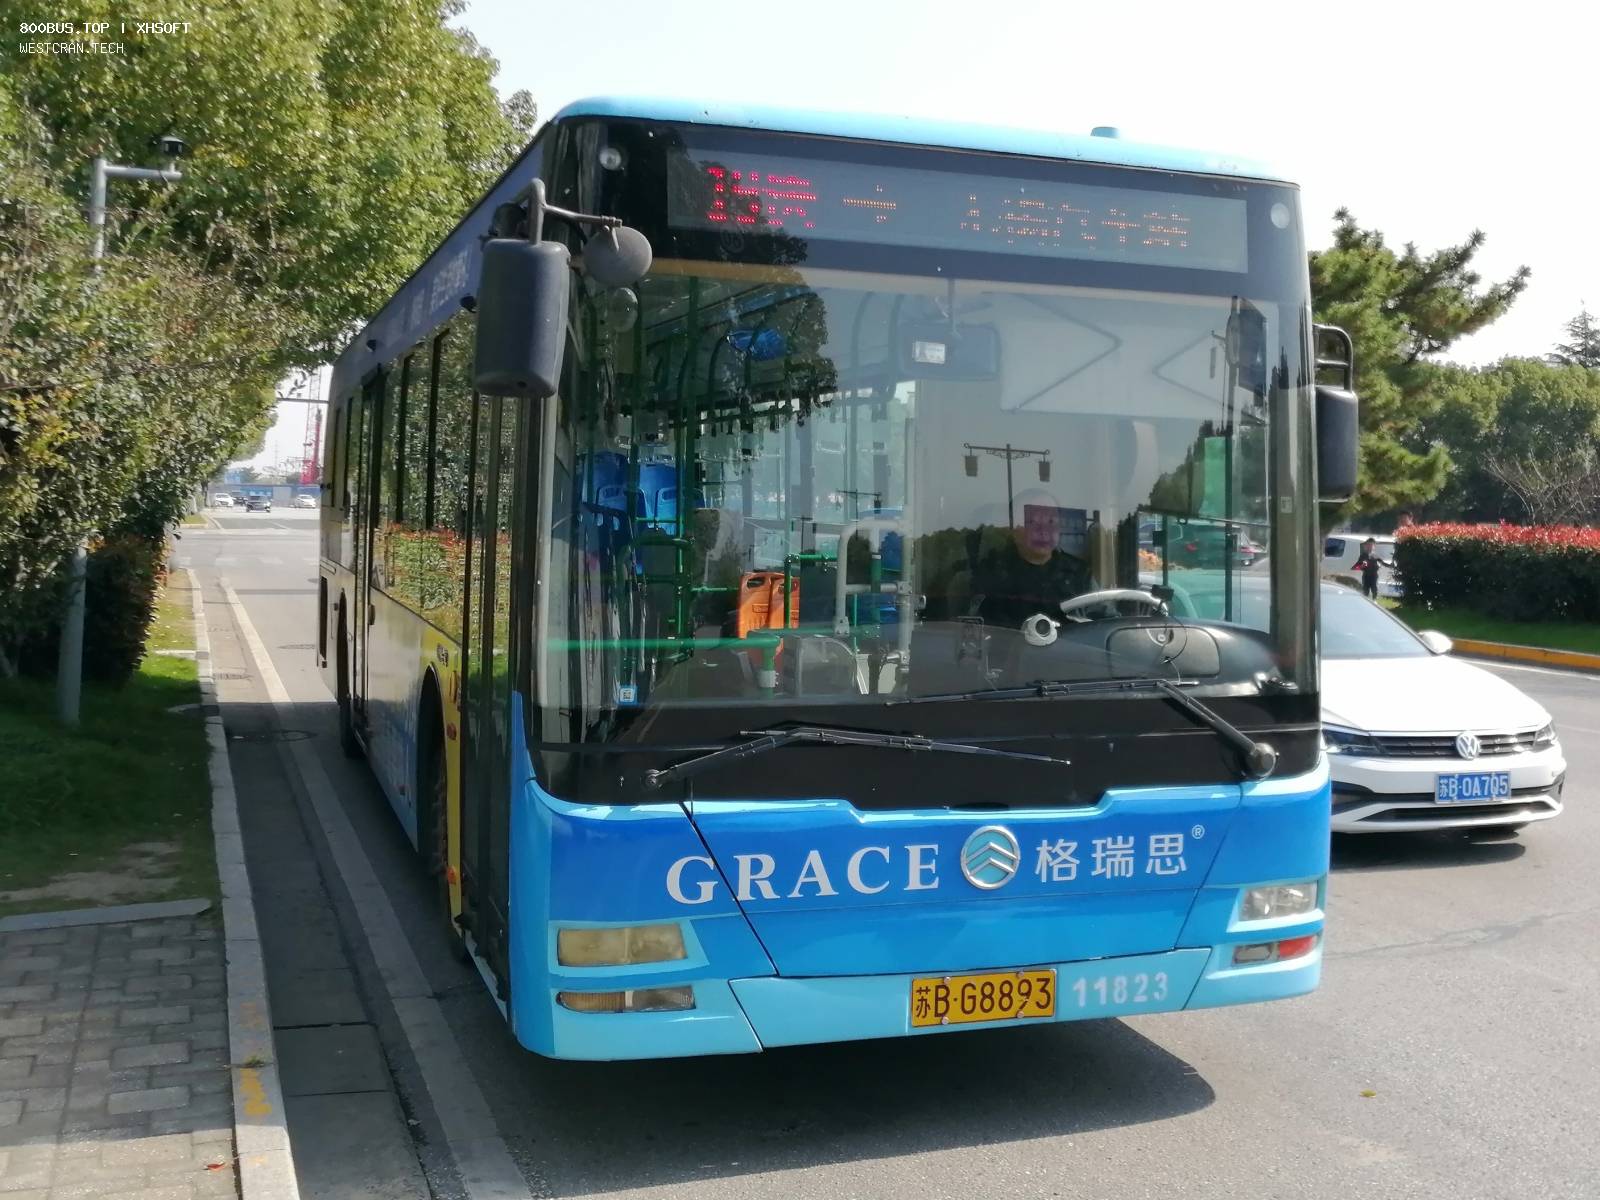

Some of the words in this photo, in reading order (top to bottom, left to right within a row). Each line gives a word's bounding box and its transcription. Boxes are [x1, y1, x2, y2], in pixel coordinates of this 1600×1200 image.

[666, 844, 940, 905] GRACE
[1035, 833, 1189, 884] 格瑞思
[1072, 971, 1169, 1008] 11823
